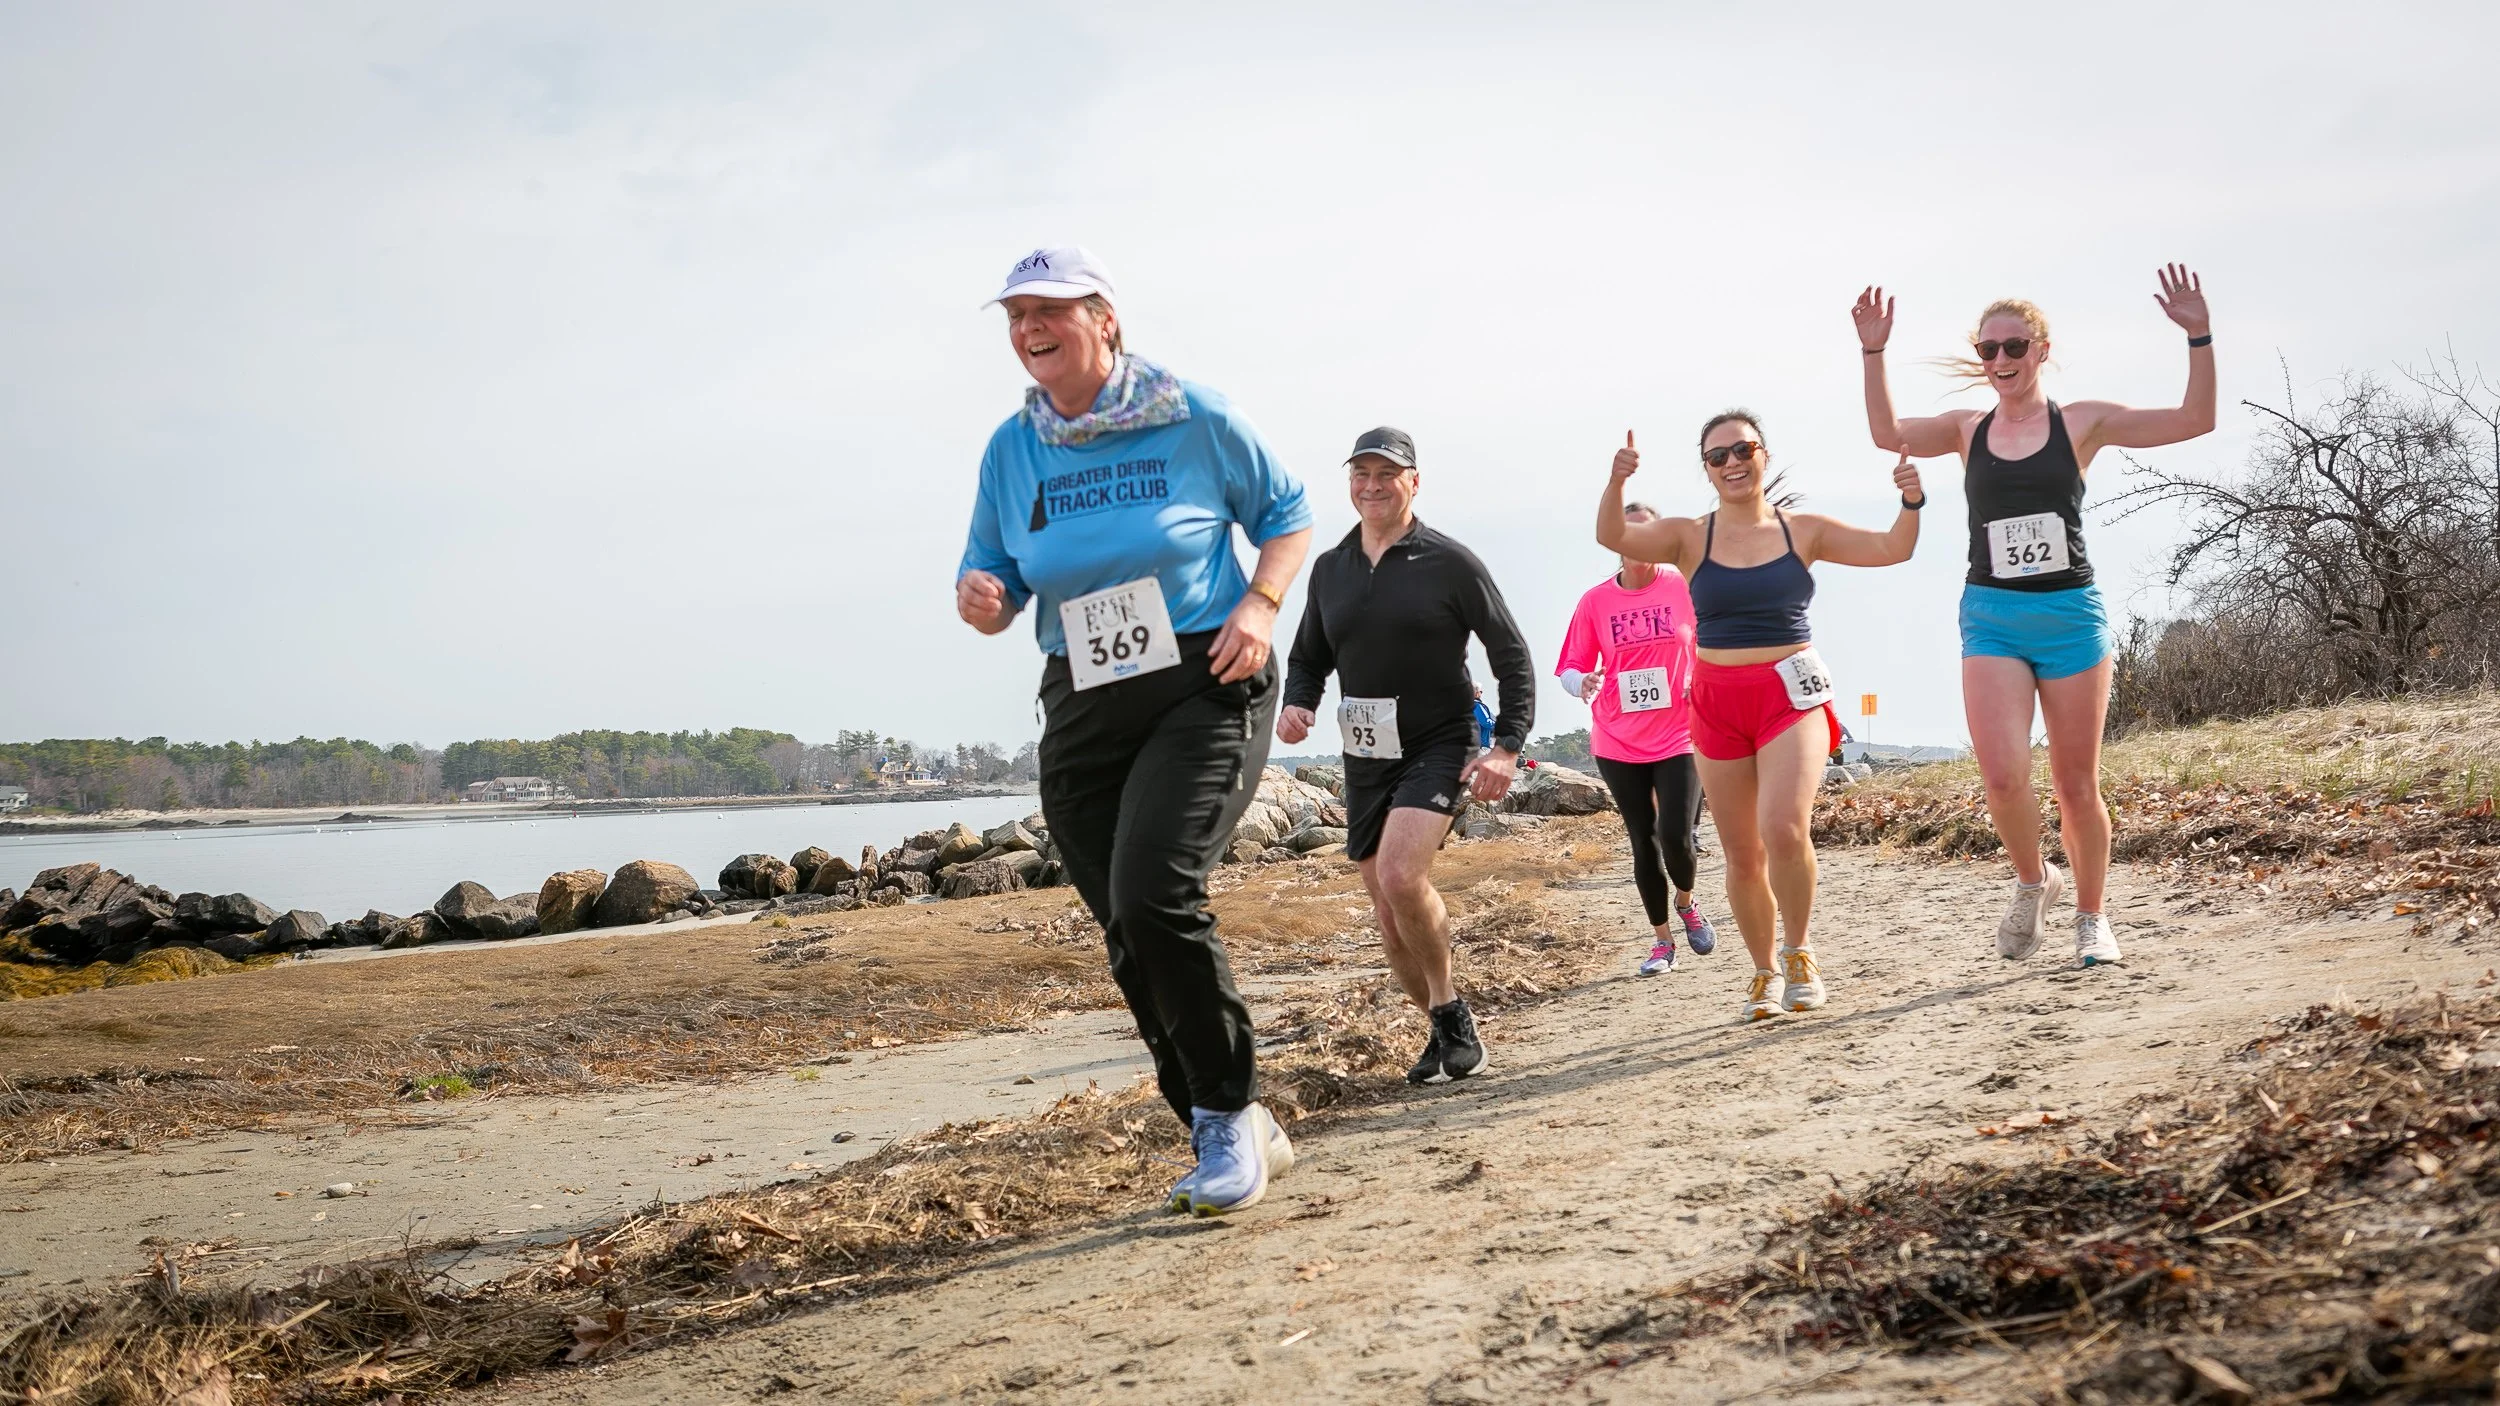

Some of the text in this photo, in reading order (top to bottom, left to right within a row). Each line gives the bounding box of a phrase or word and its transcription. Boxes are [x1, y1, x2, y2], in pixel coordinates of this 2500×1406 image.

[1047, 458, 1168, 492] GREATER DERRY
[1047, 485, 1113, 516] TRACK
[1116, 479, 1169, 502] CLUB
[2007, 542, 2052, 566] 362
[1610, 606, 1671, 623] RESCUE
[1611, 613, 1675, 644] RUN
[1088, 625, 1150, 666] 369
[1630, 687, 1659, 703] 390
[1352, 726, 1376, 747] 93
